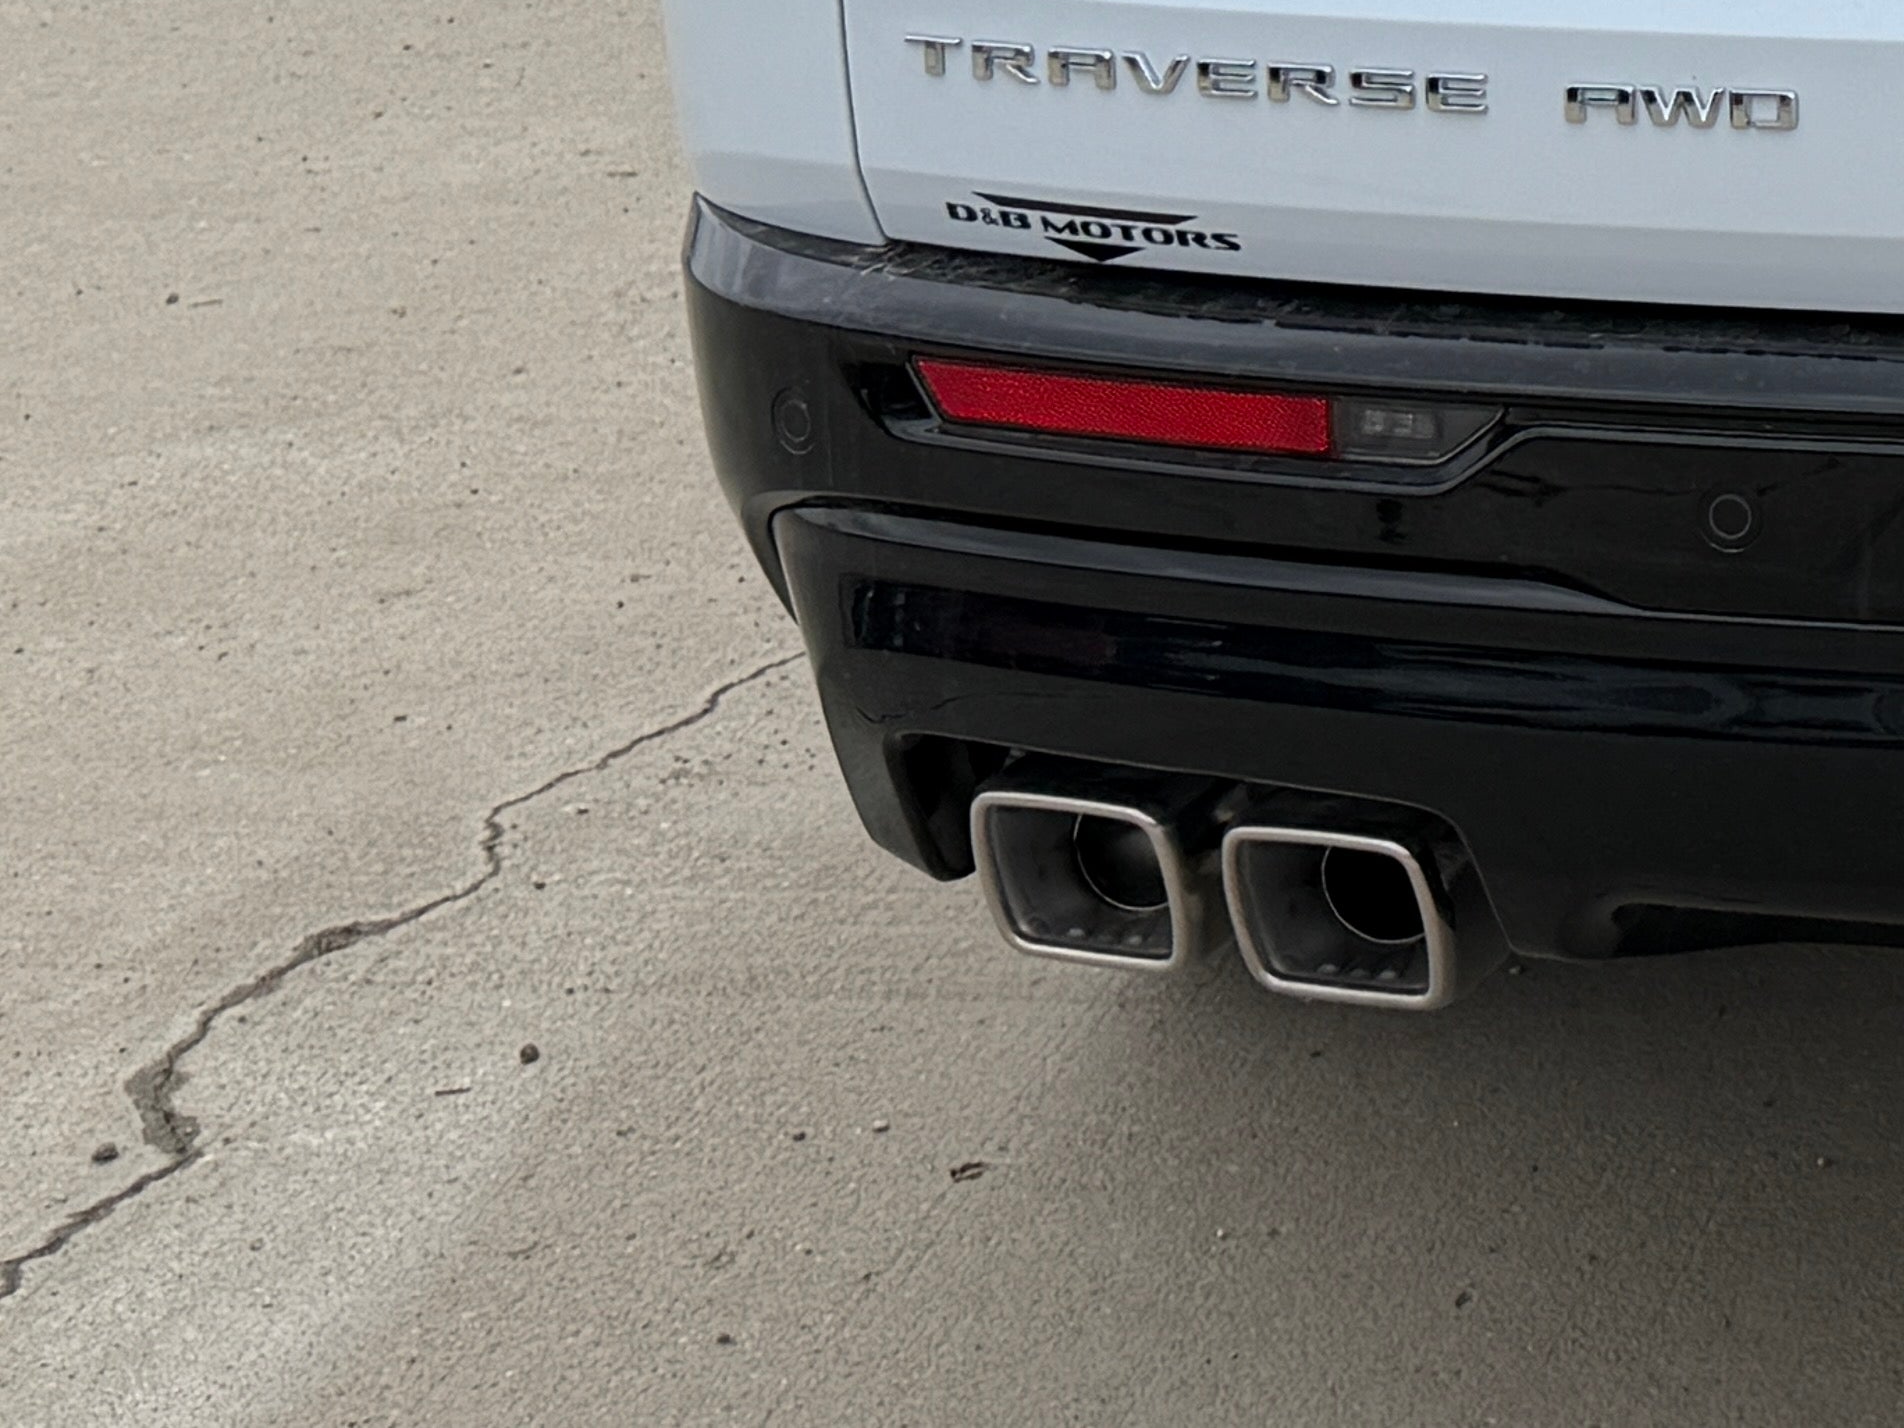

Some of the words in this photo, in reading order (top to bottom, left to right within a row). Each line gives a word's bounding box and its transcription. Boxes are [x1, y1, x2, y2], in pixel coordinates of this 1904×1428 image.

[904, 33, 1489, 116] TRAVERSE
[1563, 82, 1799, 131] AWD
[946, 201, 1032, 230] D&B
[1040, 216, 1242, 252] MOTORS
